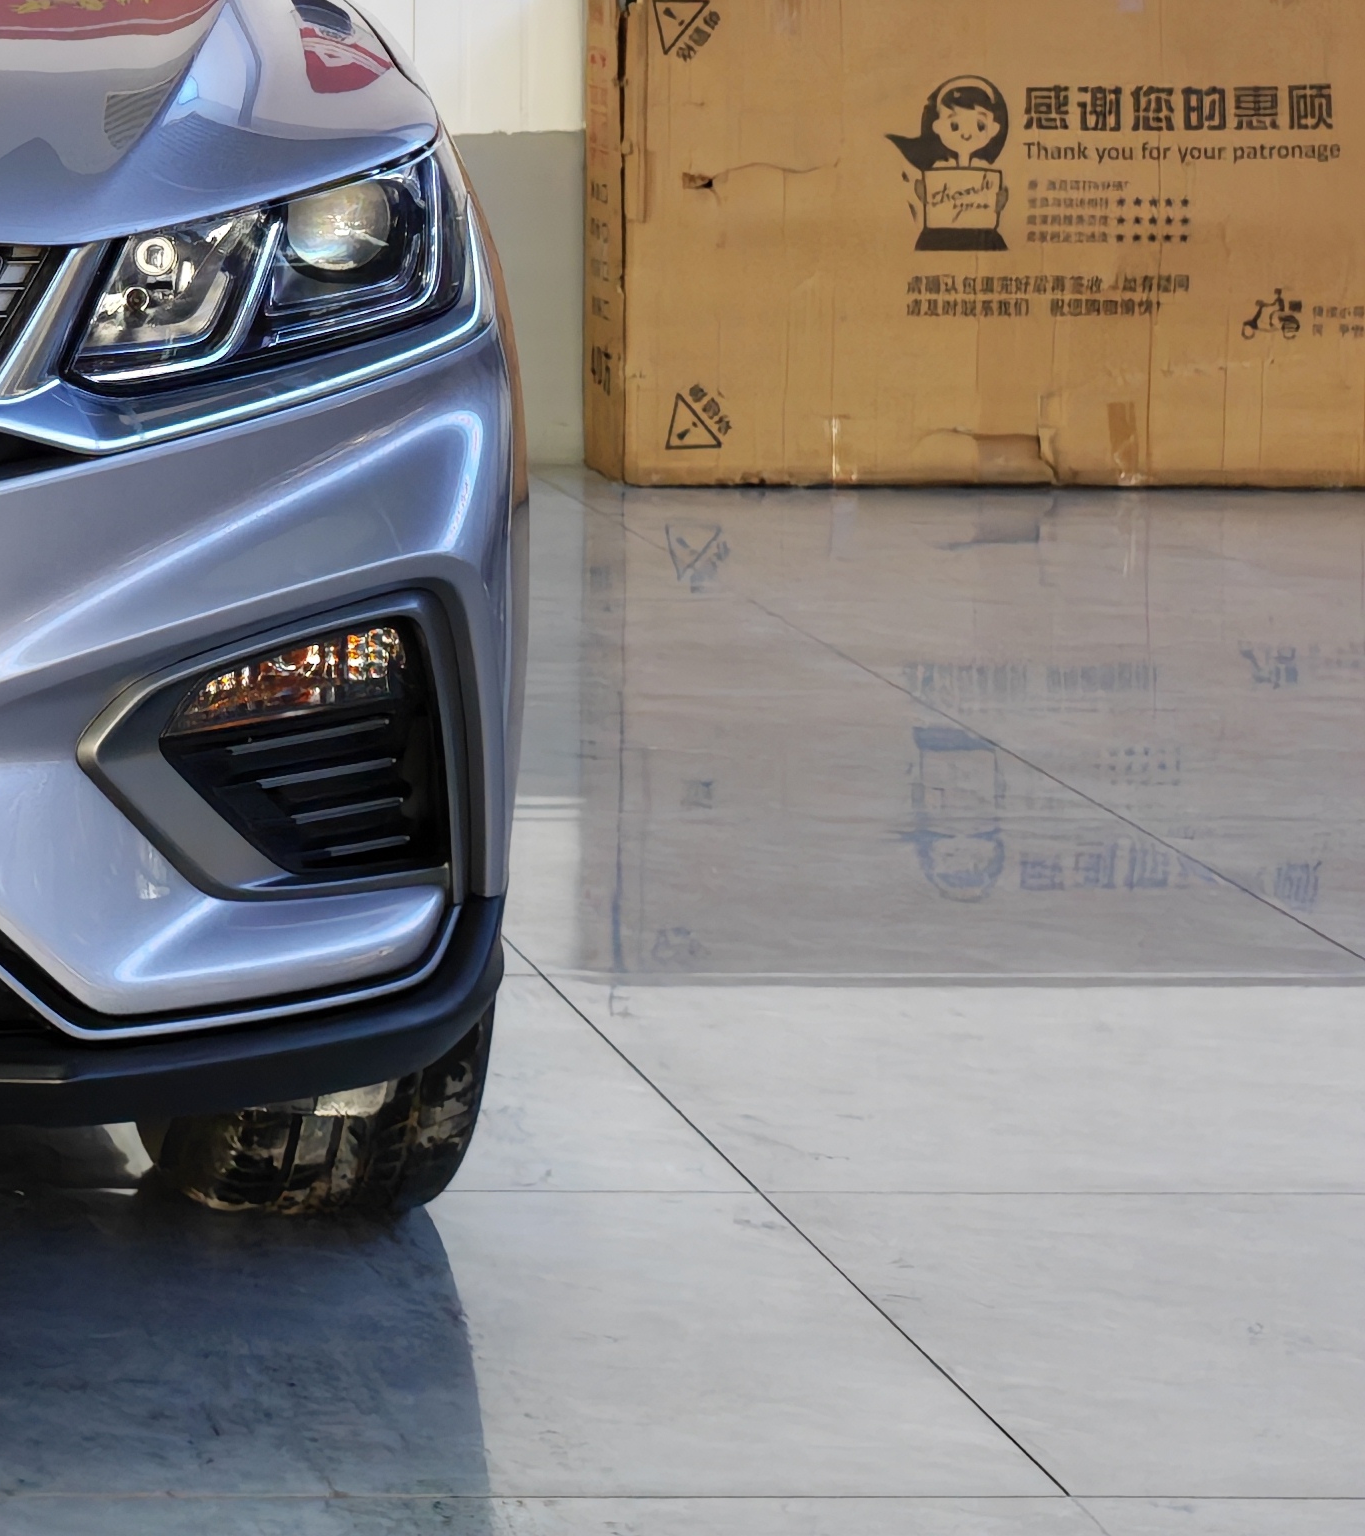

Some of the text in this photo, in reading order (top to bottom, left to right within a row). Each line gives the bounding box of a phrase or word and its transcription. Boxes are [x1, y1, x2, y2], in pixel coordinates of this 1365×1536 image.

[1023, 84, 1334, 132] 感谢您的惠顾
[1023, 141, 1341, 164] Thank you for your patronage
